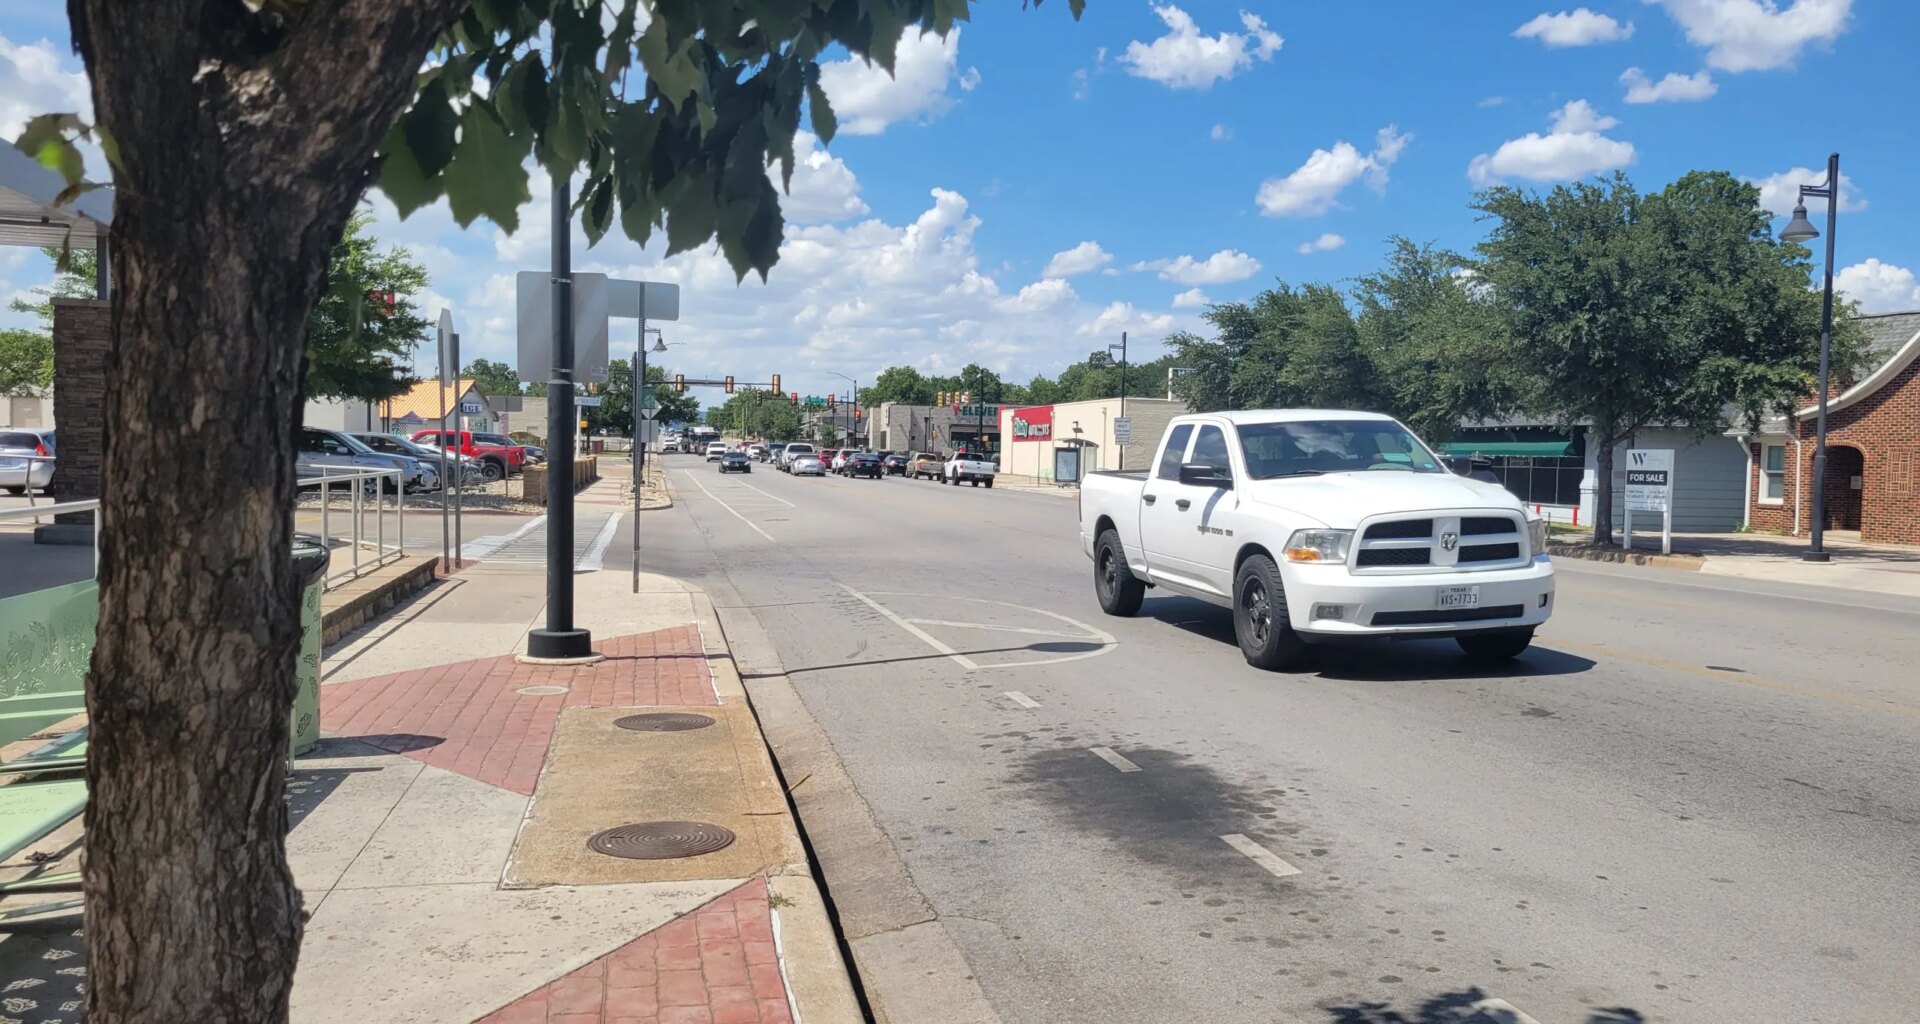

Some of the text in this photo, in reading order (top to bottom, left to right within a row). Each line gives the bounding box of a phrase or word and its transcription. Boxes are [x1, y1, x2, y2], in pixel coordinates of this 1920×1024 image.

[464, 405, 481, 413] ICE
[1631, 453, 1647, 466] W
[1629, 474, 1664, 482] FOR SALE
